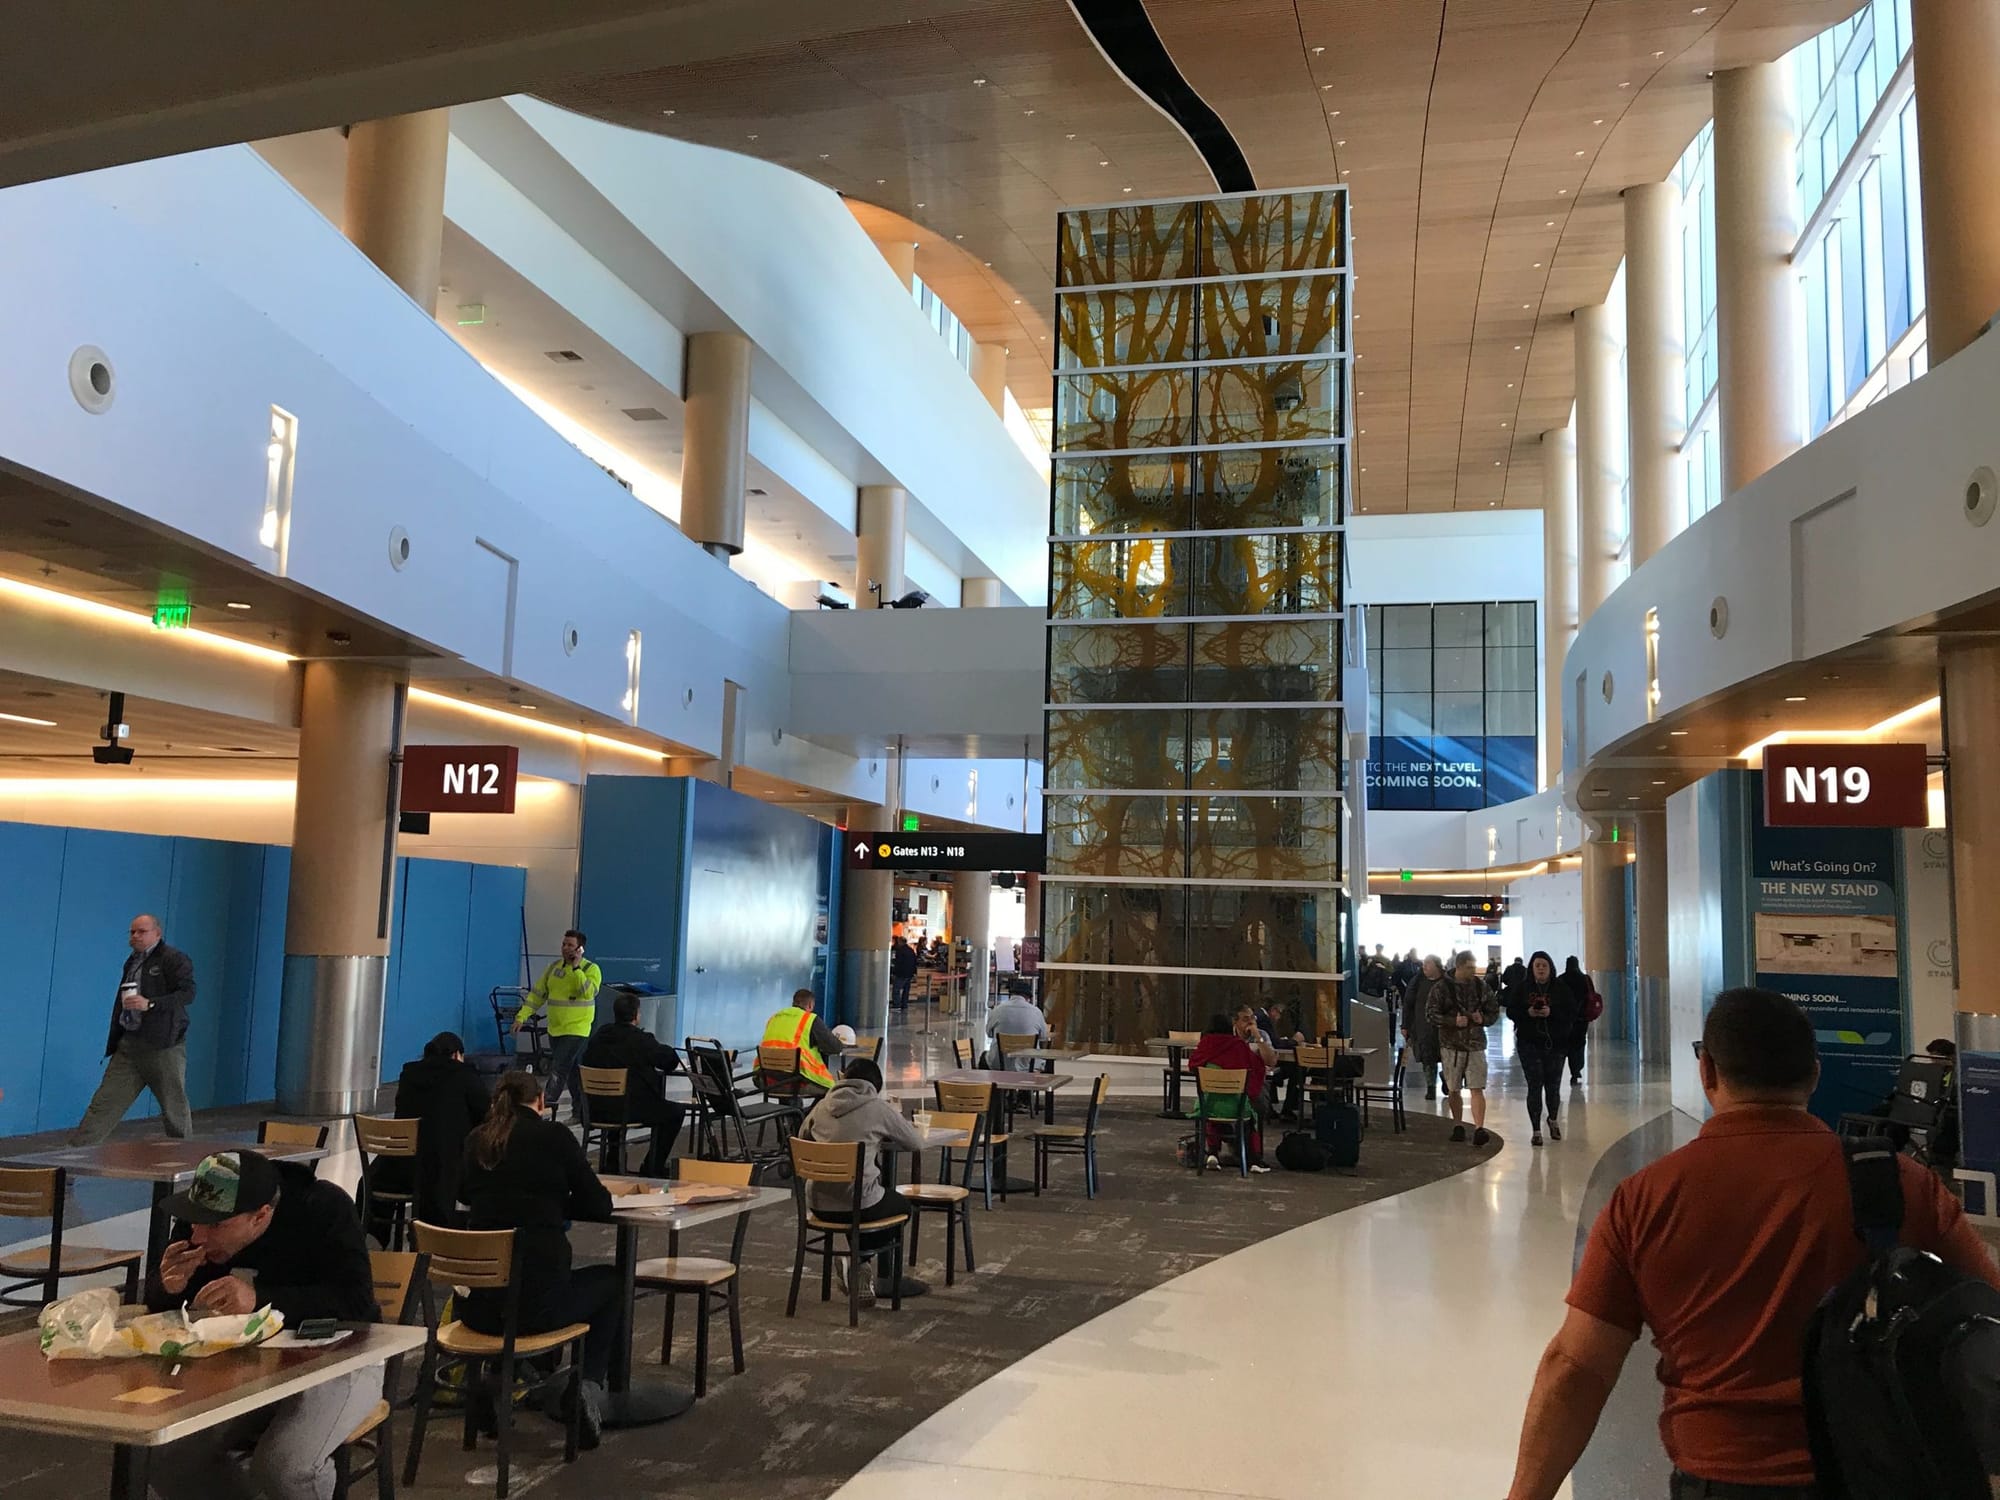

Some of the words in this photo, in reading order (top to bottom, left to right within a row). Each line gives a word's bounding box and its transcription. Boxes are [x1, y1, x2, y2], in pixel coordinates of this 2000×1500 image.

[1384, 762, 1407, 772] THE
[1410, 762, 1441, 772] NEXT
[1443, 763, 1481, 772] LEVEL.
[443, 763, 499, 794] N12
[1366, 775, 1429, 787] COMING
[1433, 775, 1481, 787] SOON.
[1785, 766, 1870, 804] N19
[892, 845, 919, 857] Gates
[920, 846, 938, 857] N13
[946, 846, 965, 857] N18
[1769, 860, 1811, 872] What's
[1813, 860, 1850, 875] Going
[1853, 861, 1877, 873] On?
[1923, 861, 1947, 869] STAN
[1760, 882, 1787, 894] THE
[1791, 882, 1826, 896] NEW
[1830, 883, 1879, 896] STAND
[1927, 970, 1952, 978] STAN
